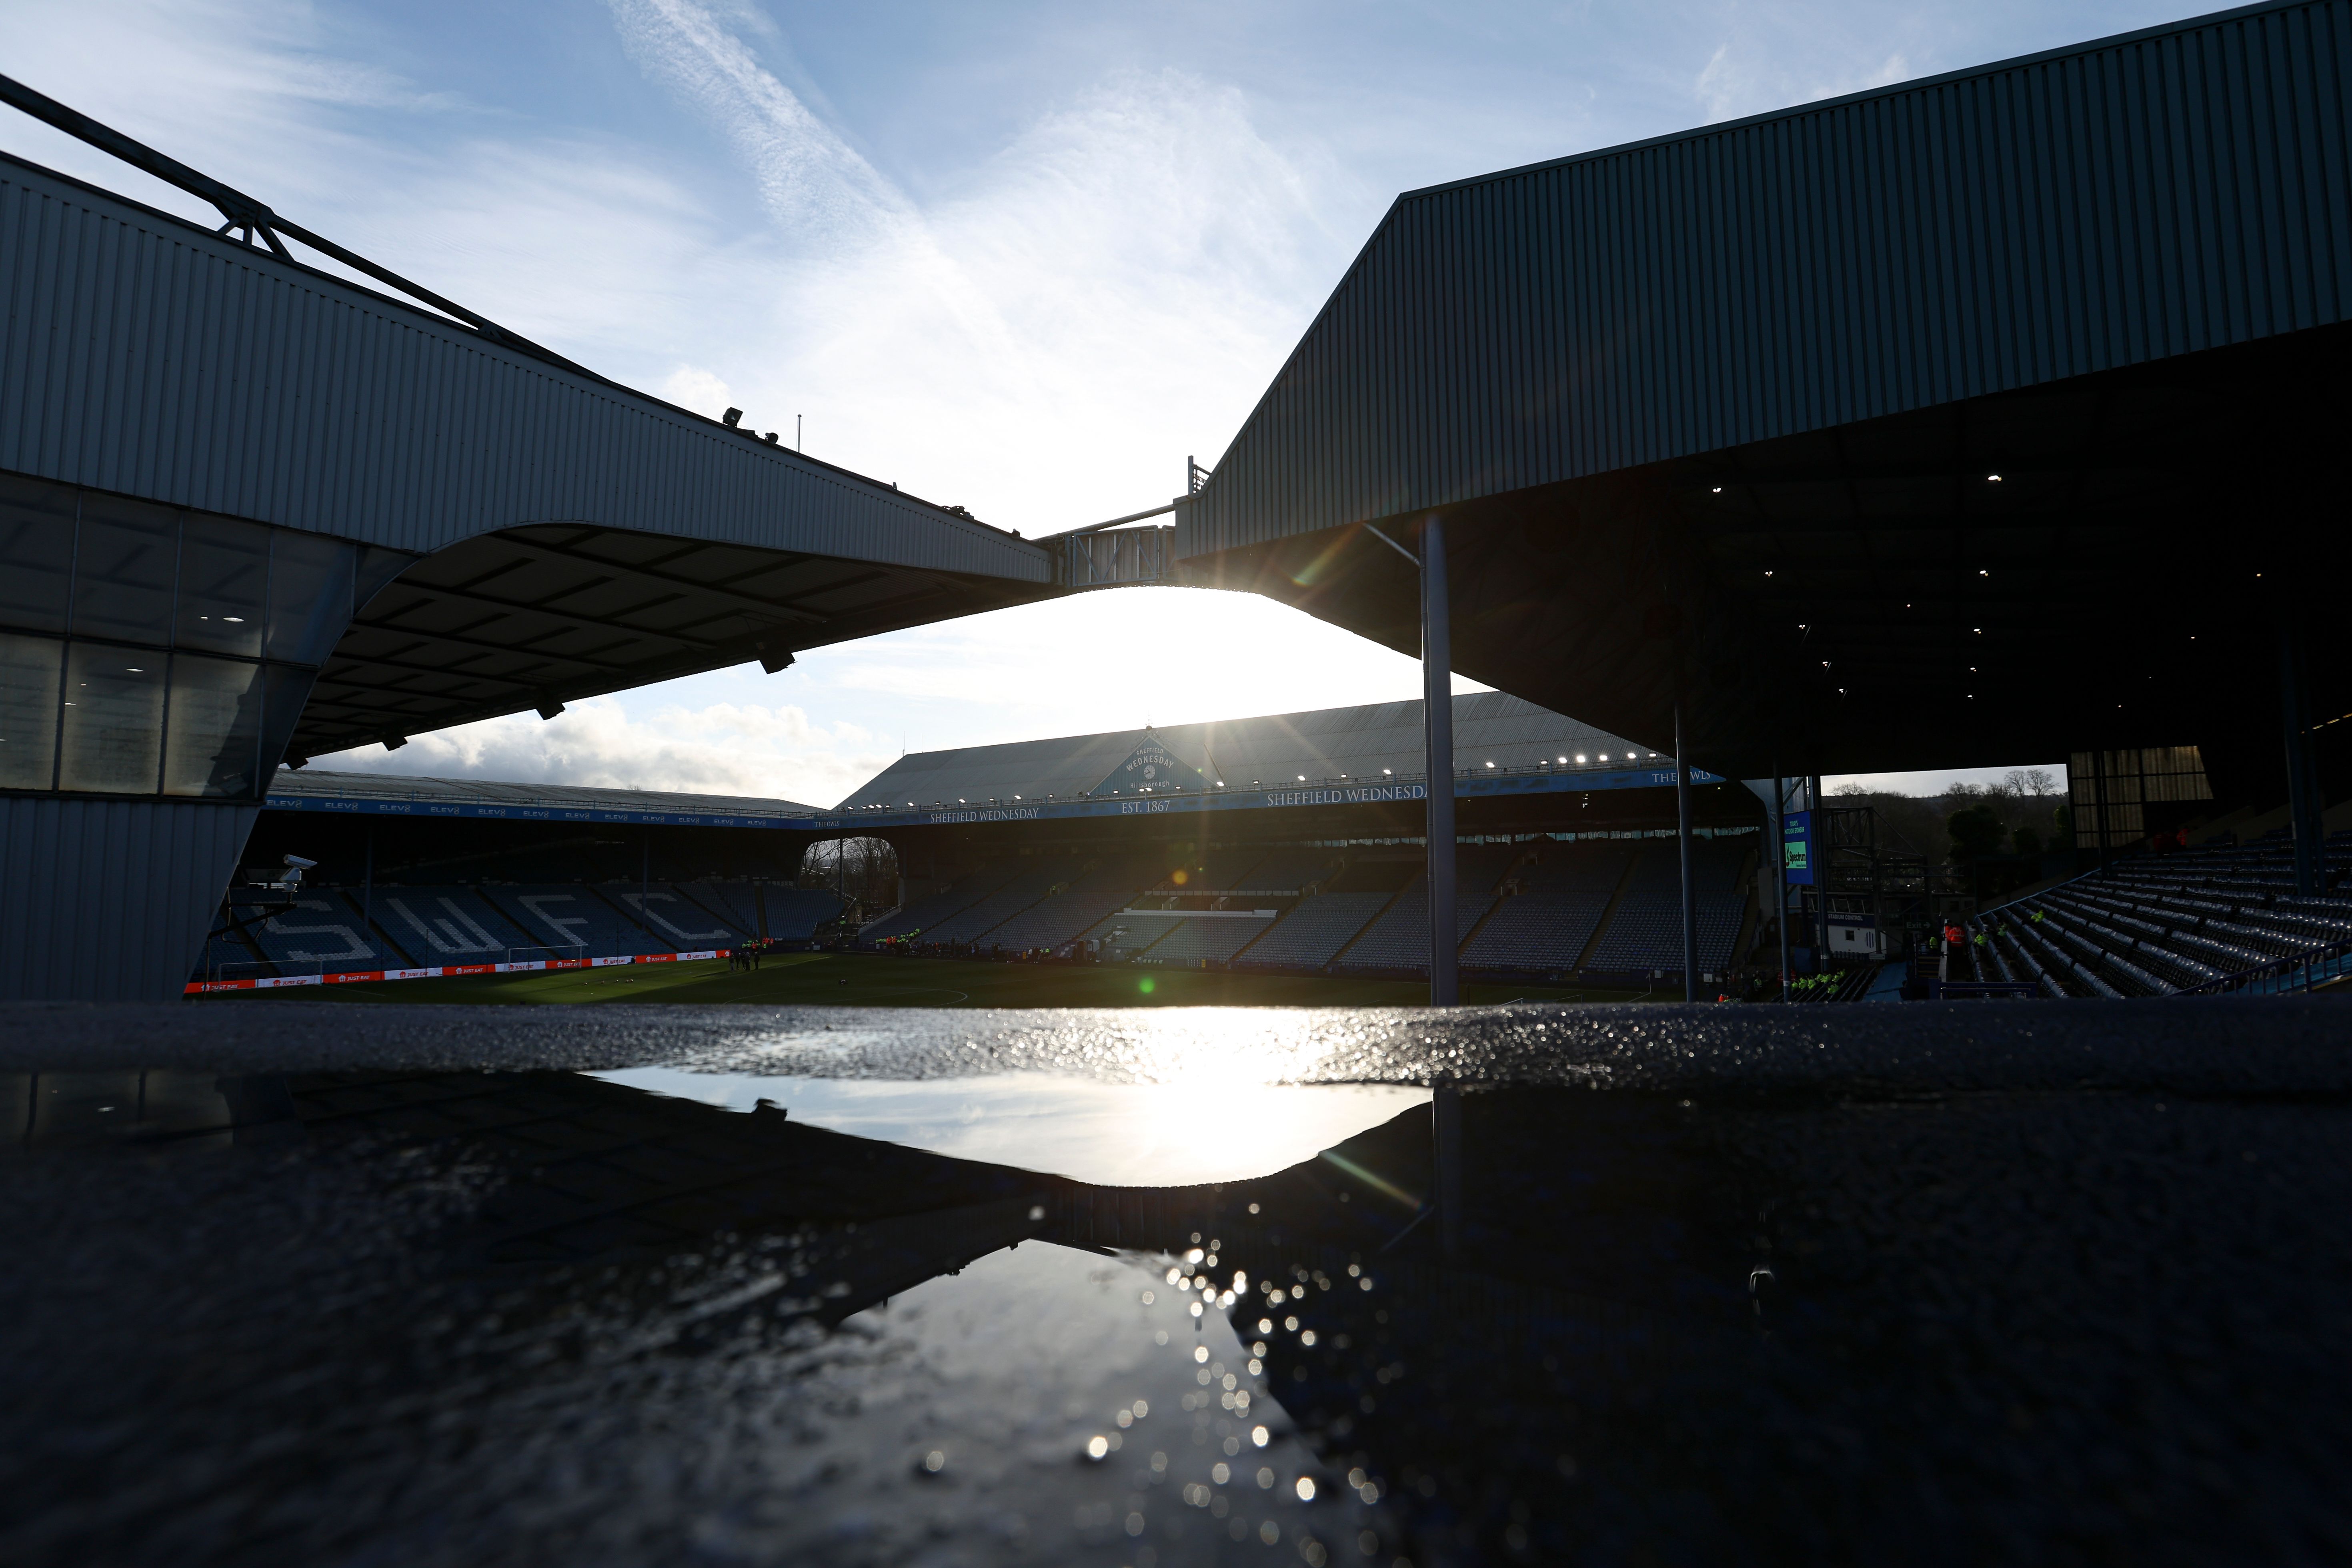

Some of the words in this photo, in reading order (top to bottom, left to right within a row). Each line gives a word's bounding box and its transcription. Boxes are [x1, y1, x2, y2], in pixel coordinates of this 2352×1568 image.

[1136, 748, 1163, 756] SHEFFIELD
[1126, 755, 1174, 772] WEDNESDAY
[1652, 773, 1677, 783] THE
[1689, 770, 1710, 780] WLS
[1130, 780, 1169, 788] Hillsborough
[1267, 790, 1341, 806] SHEFFIELD
[1346, 786, 1427, 802] WEDNESD
[1122, 802, 1142, 813] EST.
[1146, 800, 1170, 812] 1867
[930, 812, 977, 823] SHEFFIELD
[979, 808, 1039, 821] WEDNESDAY
[1790, 851, 1806, 864] Spectrum
